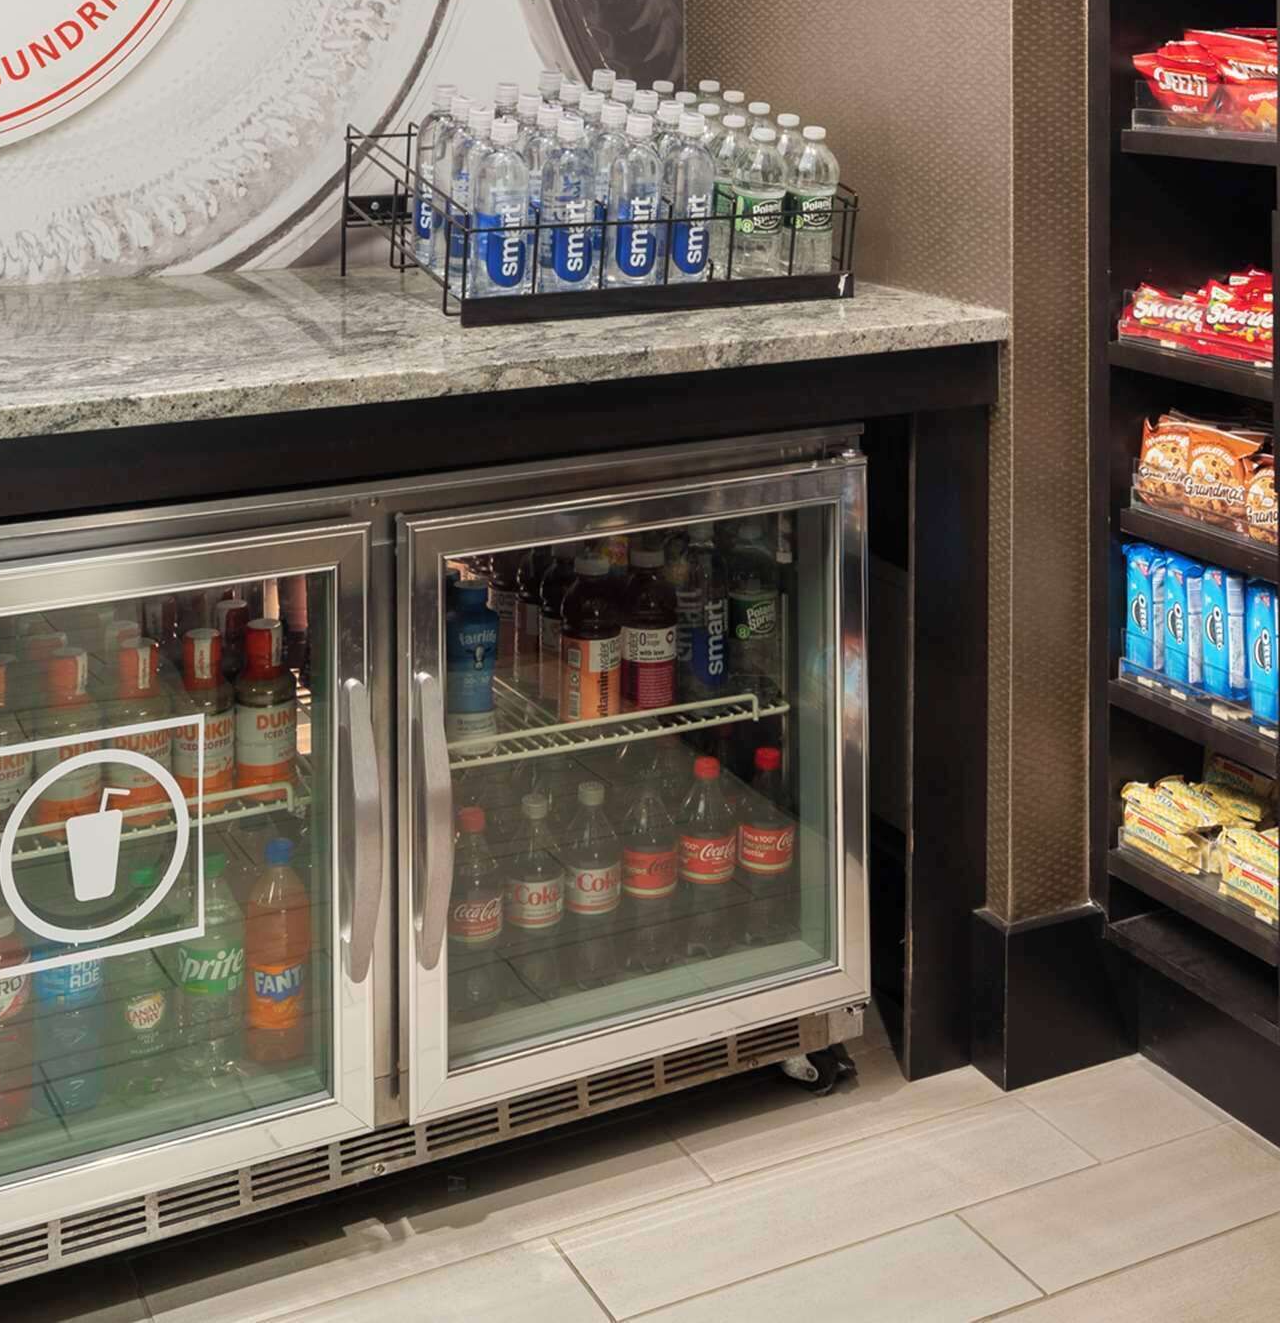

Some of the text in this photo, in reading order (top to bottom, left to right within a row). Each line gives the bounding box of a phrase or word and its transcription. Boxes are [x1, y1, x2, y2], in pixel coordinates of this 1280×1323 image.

[705, 600, 723, 674] smart
[178, 947, 243, 981] Sprite
[255, 965, 301, 995] FANT
